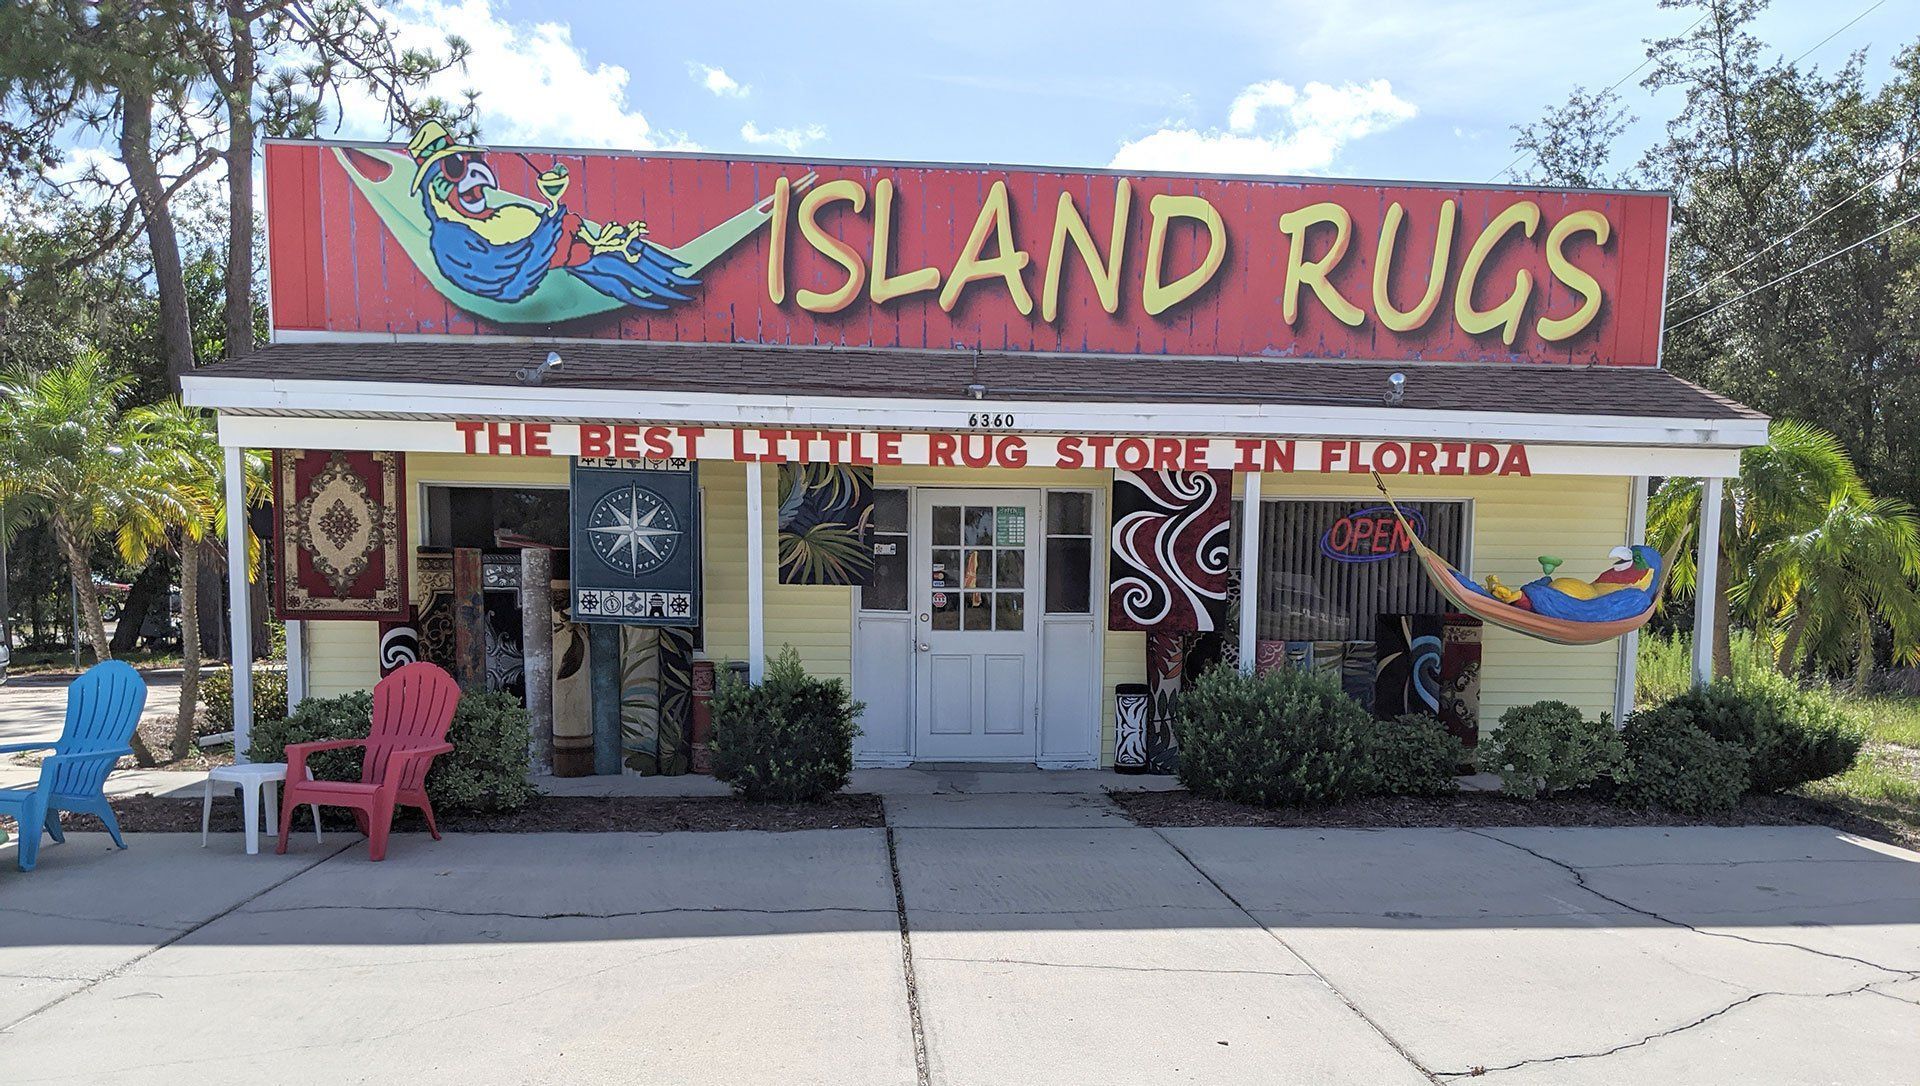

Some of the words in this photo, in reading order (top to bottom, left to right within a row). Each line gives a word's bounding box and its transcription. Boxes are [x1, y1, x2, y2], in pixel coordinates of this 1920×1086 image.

[767, 176, 1227, 323] ISLAND
[1279, 198, 1612, 345] RUGS
[968, 413, 1015, 428] 6360
[455, 421, 552, 458] THE
[579, 424, 706, 460] BEST
[733, 428, 902, 466] LITTLE
[929, 434, 1028, 469] RUG
[1056, 437, 1210, 472] STORE
[1235, 440, 1296, 473] IN
[1320, 441, 1531, 476] FLORIDA
[1330, 516, 1416, 553] OPEN
